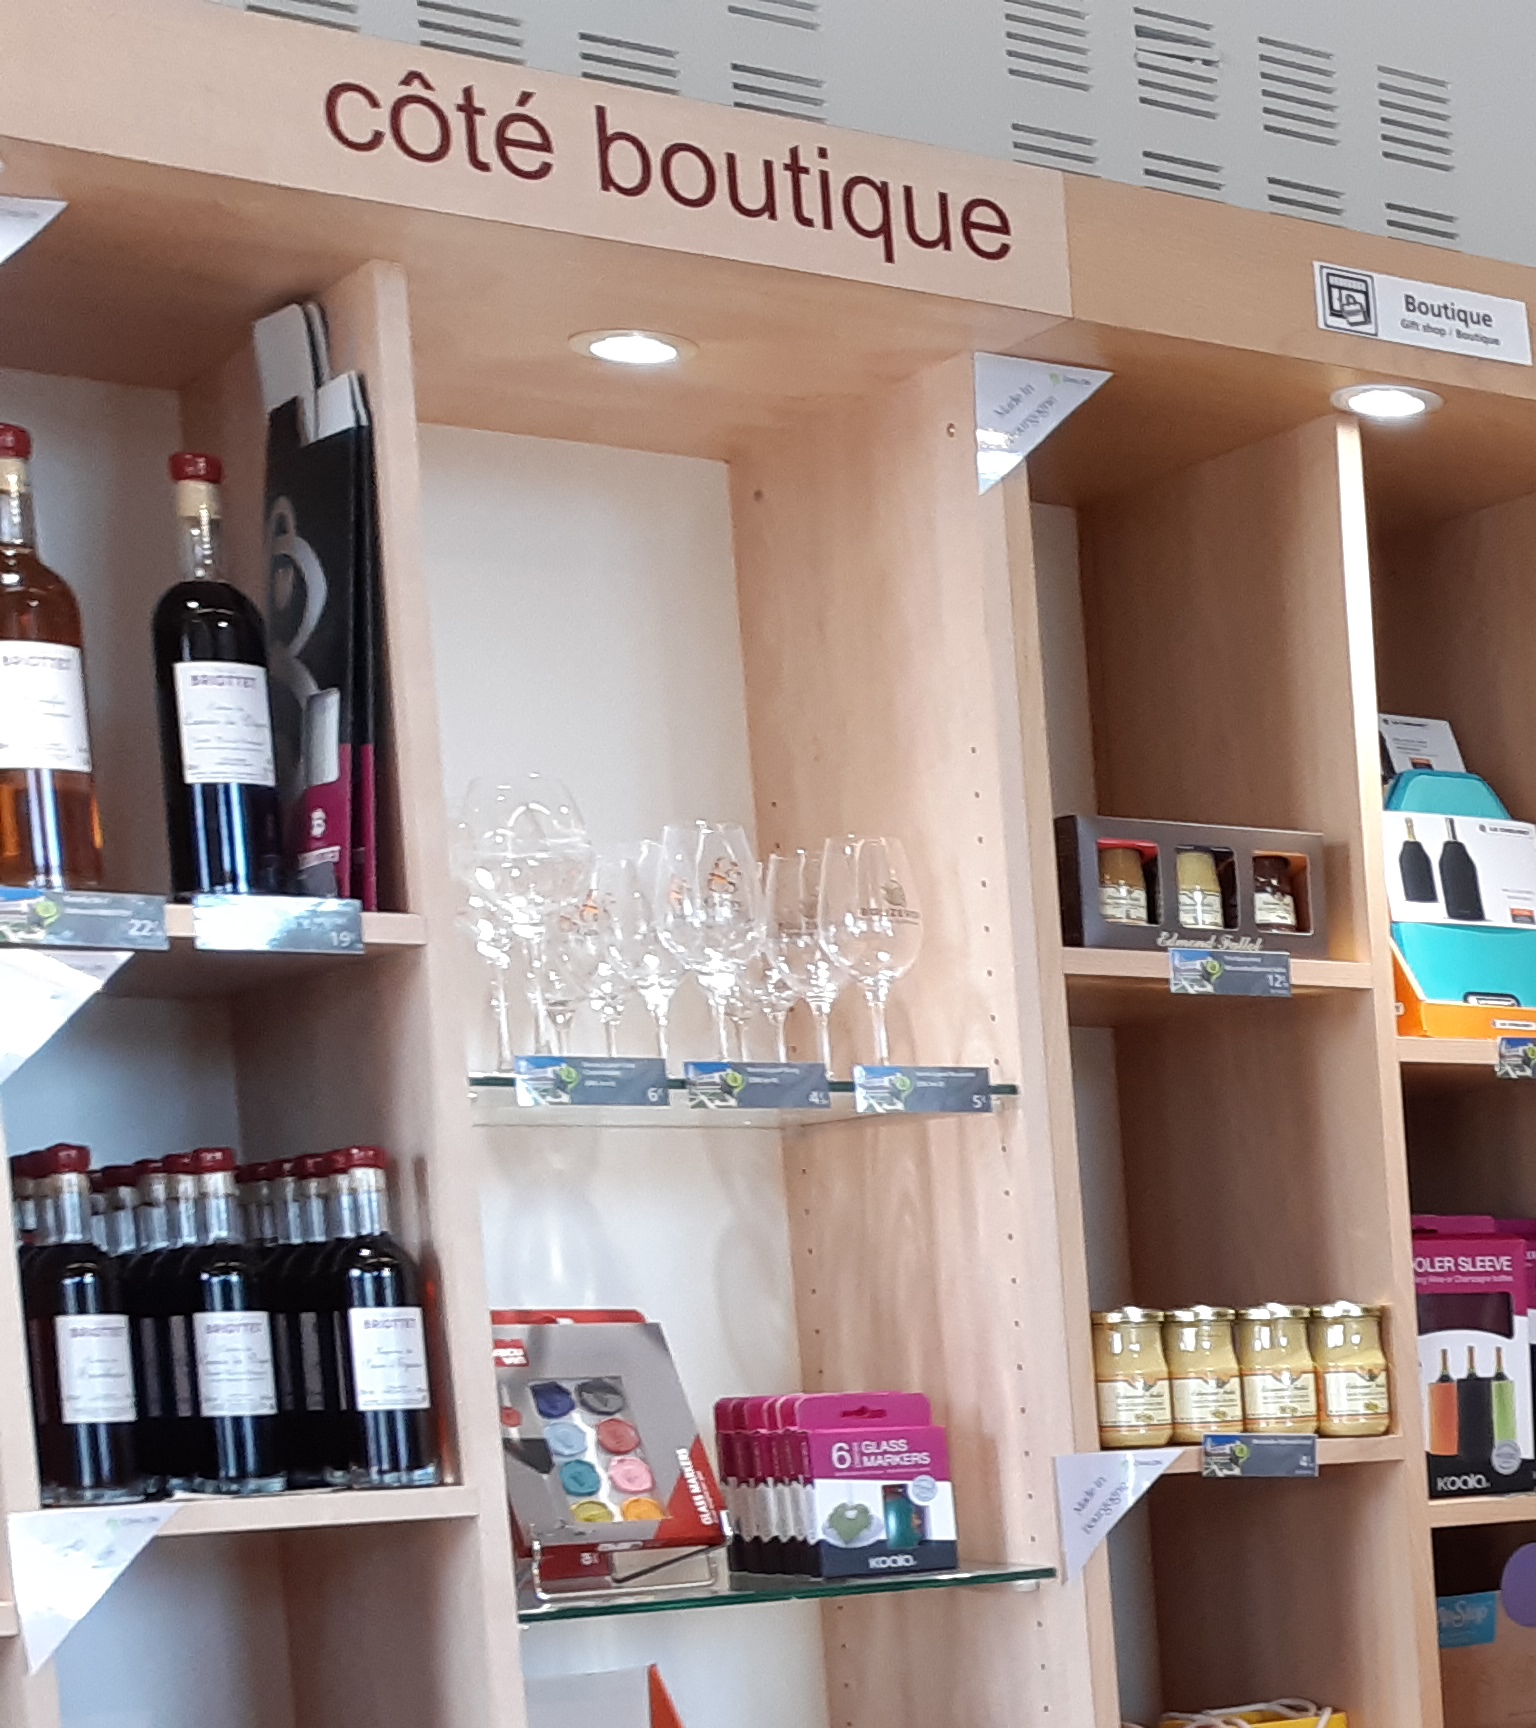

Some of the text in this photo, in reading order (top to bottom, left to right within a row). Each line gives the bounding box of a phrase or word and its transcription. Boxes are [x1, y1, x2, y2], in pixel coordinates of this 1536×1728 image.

[324, 71, 1015, 263] côté boutique
[1403, 293, 1494, 328] Boutique
[1400, 318, 1421, 331] Gift
[1422, 322, 1448, 340] shop
[1455, 329, 1501, 346] Boutique
[1456, 1255, 1513, 1273] SLEEVE
[831, 1439, 909, 1469] 6 GLASS
[861, 1452, 931, 1468] MARKERS
